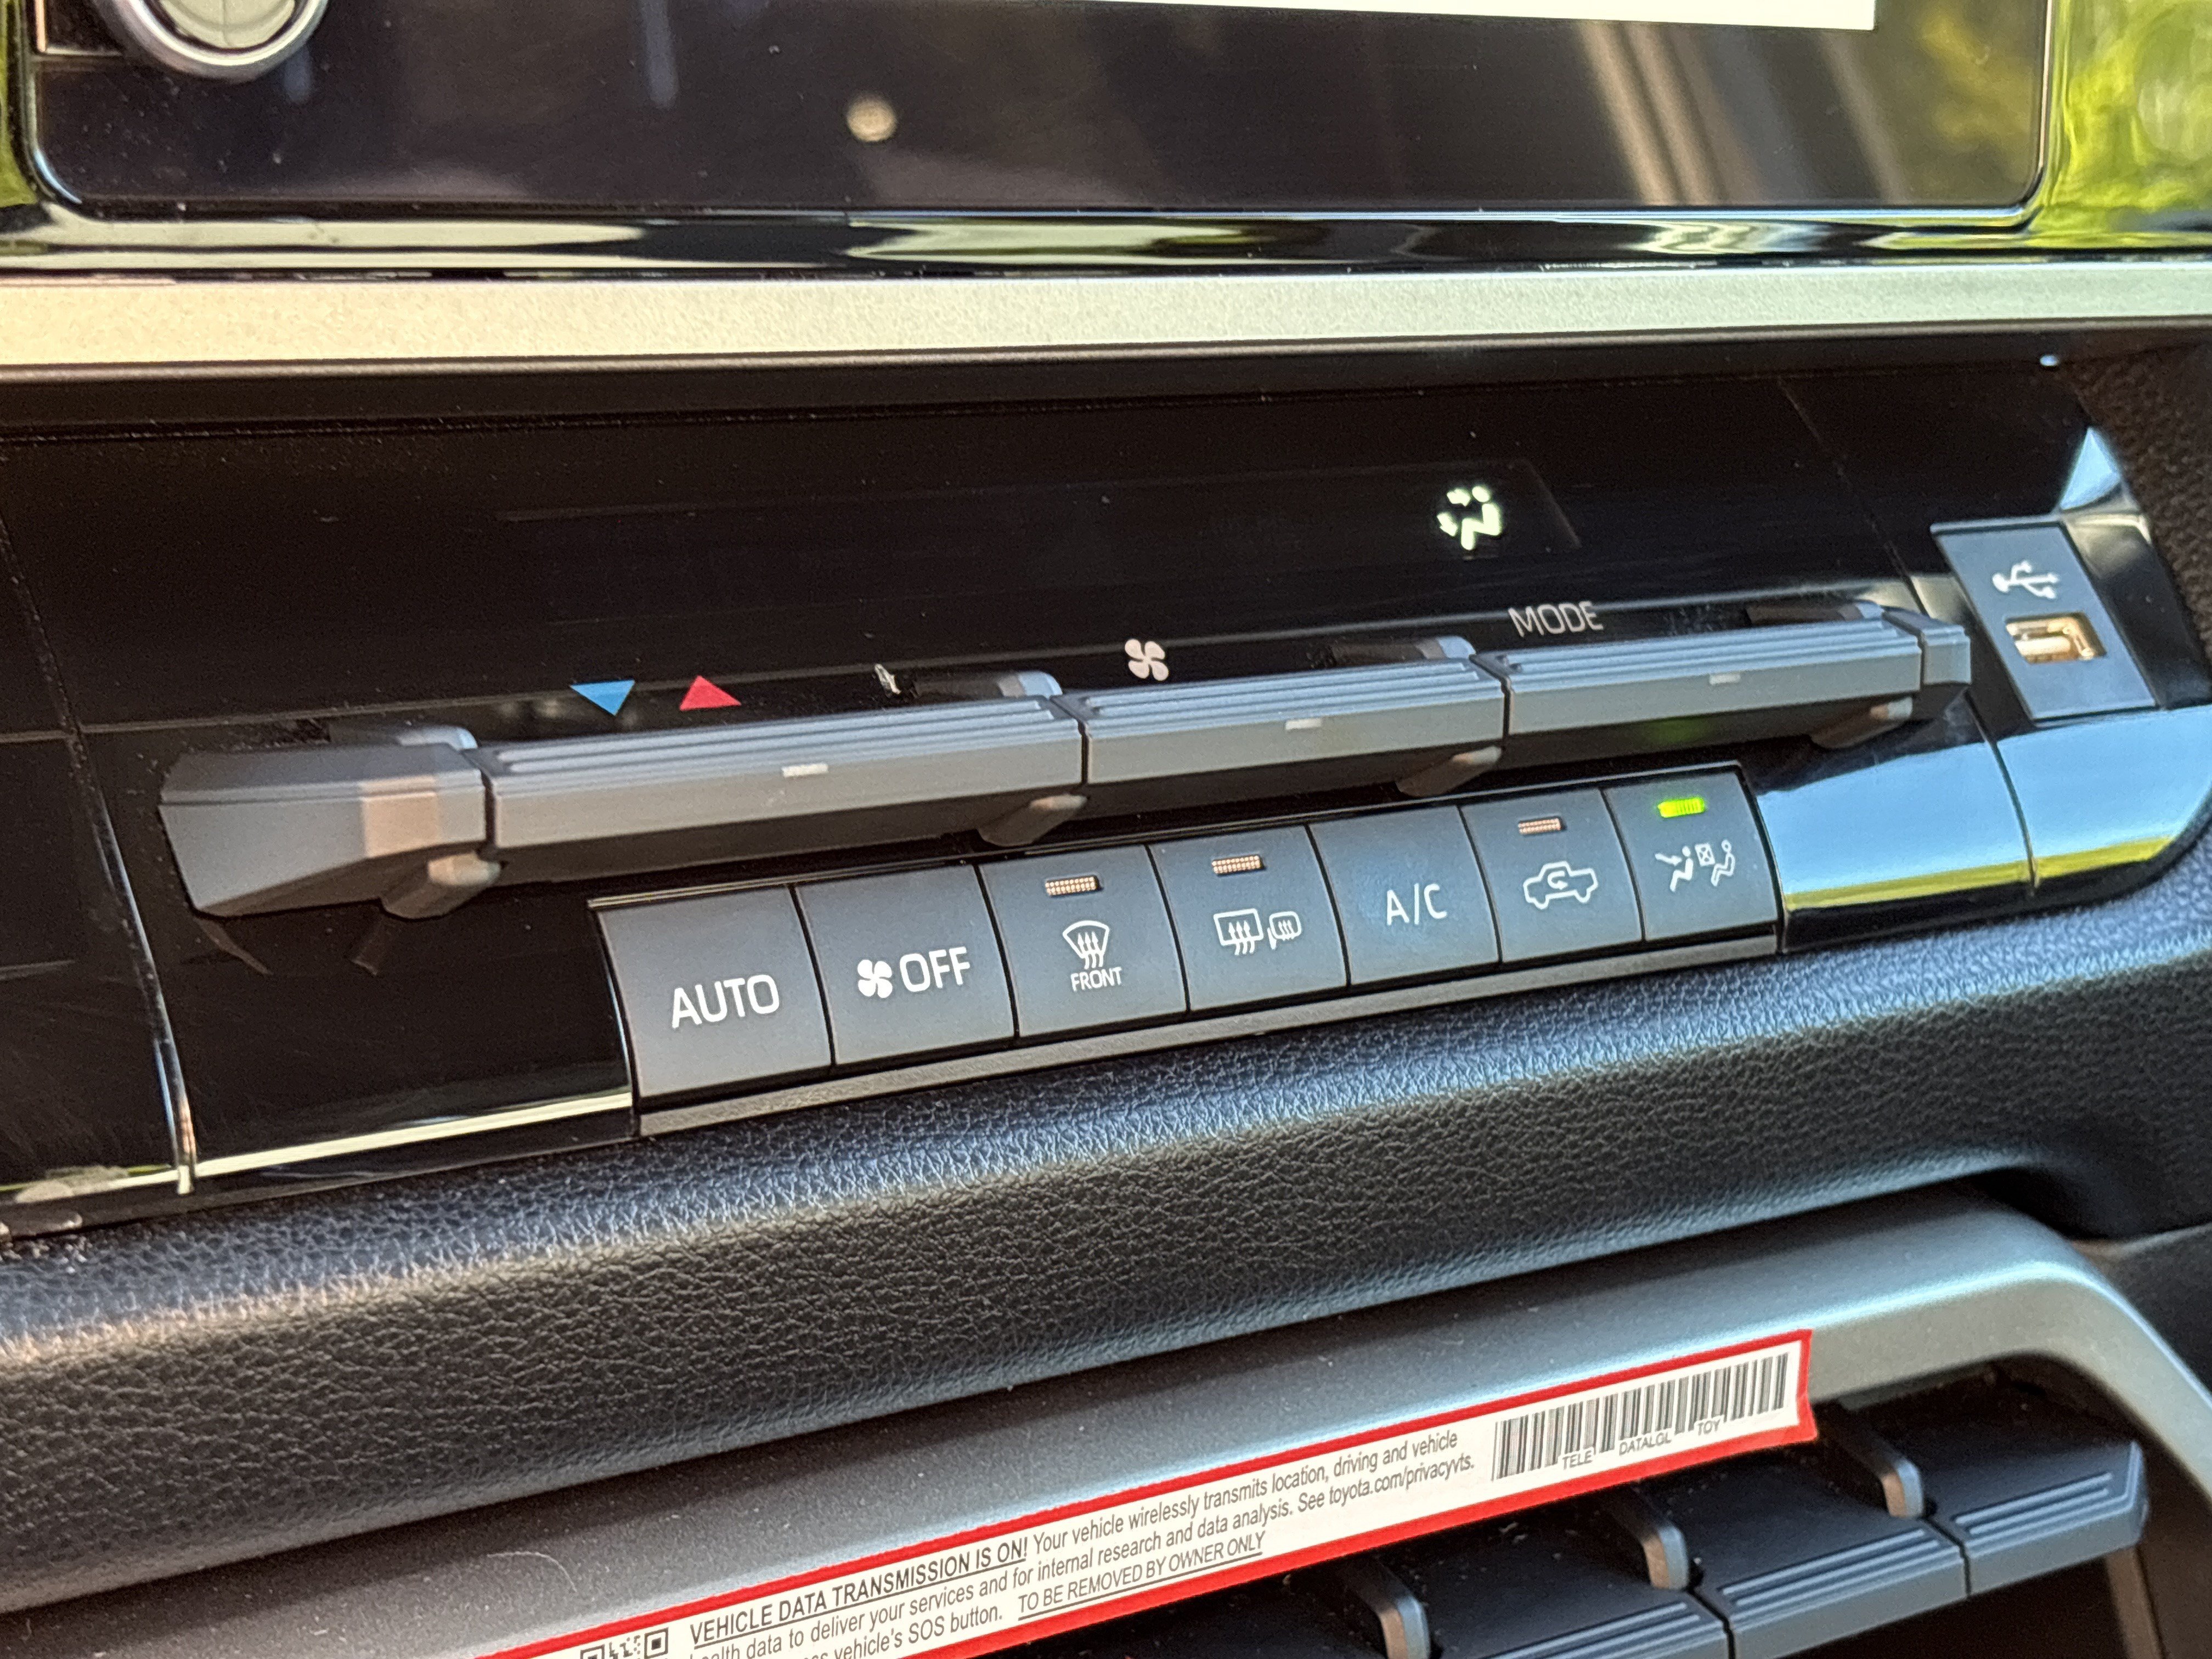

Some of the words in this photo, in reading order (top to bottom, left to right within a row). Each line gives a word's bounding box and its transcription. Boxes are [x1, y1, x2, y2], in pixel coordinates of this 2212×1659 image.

[1508, 601, 1604, 637] MODE
[1385, 884, 1447, 926] A/C
[900, 946, 970, 992] OFF
[1070, 966, 1122, 991] FRONT
[672, 975, 780, 1028] AUTO
[1562, 1449, 1593, 1470] TELE
[1697, 1419, 1721, 1436] TOY
[690, 1604, 772, 1645] VEHICLE
[780, 1590, 827, 1621] DATA
[832, 1551, 970, 1606] TRANSMISSION
[977, 1547, 991, 1573] IS
[997, 1537, 1028, 1562] ON!
[1034, 1531, 1068, 1554] Your
[1073, 1514, 1124, 1544] vehicle
[1128, 1494, 1200, 1530] wirelessly
[1204, 1479, 1267, 1510] transmits
[1272, 1464, 1329, 1493] location,
[1334, 1451, 1378, 1477] driving
[1383, 1440, 1408, 1465] and
[1412, 1430, 1458, 1457] vehicle
[747, 1634, 782, 1659] data
[789, 1628, 804, 1648] to
[811, 1612, 865, 1642] deliver
[870, 1602, 905, 1633] your
[910, 1585, 974, 1616] services
[979, 1570, 1008, 1596] and
[1013, 1567, 1034, 1588] for
[1037, 1548, 1093, 1581] internal
[1098, 1531, 1161, 1565] research
[1166, 1521, 1193, 1547] and
[1198, 1514, 1228, 1538] data
[1233, 1498, 1293, 1529] analysis.
[1298, 1491, 1325, 1512] See
[1329, 1453, 1475, 1506] toyota.com/privacyvts.
[834, 1628, 902, 1659] vehicle's
[909, 1615, 945, 1644] SOS
[950, 1605, 1002, 1633] button.
[1018, 1592, 1039, 1612] TO
[1043, 1584, 1063, 1606] BE
[1067, 1564, 1143, 1600] REMOVED
[1146, 1556, 1167, 1578] BY
[1169, 1542, 1224, 1572] OWNER
[1227, 1530, 1266, 1556] ONLY
